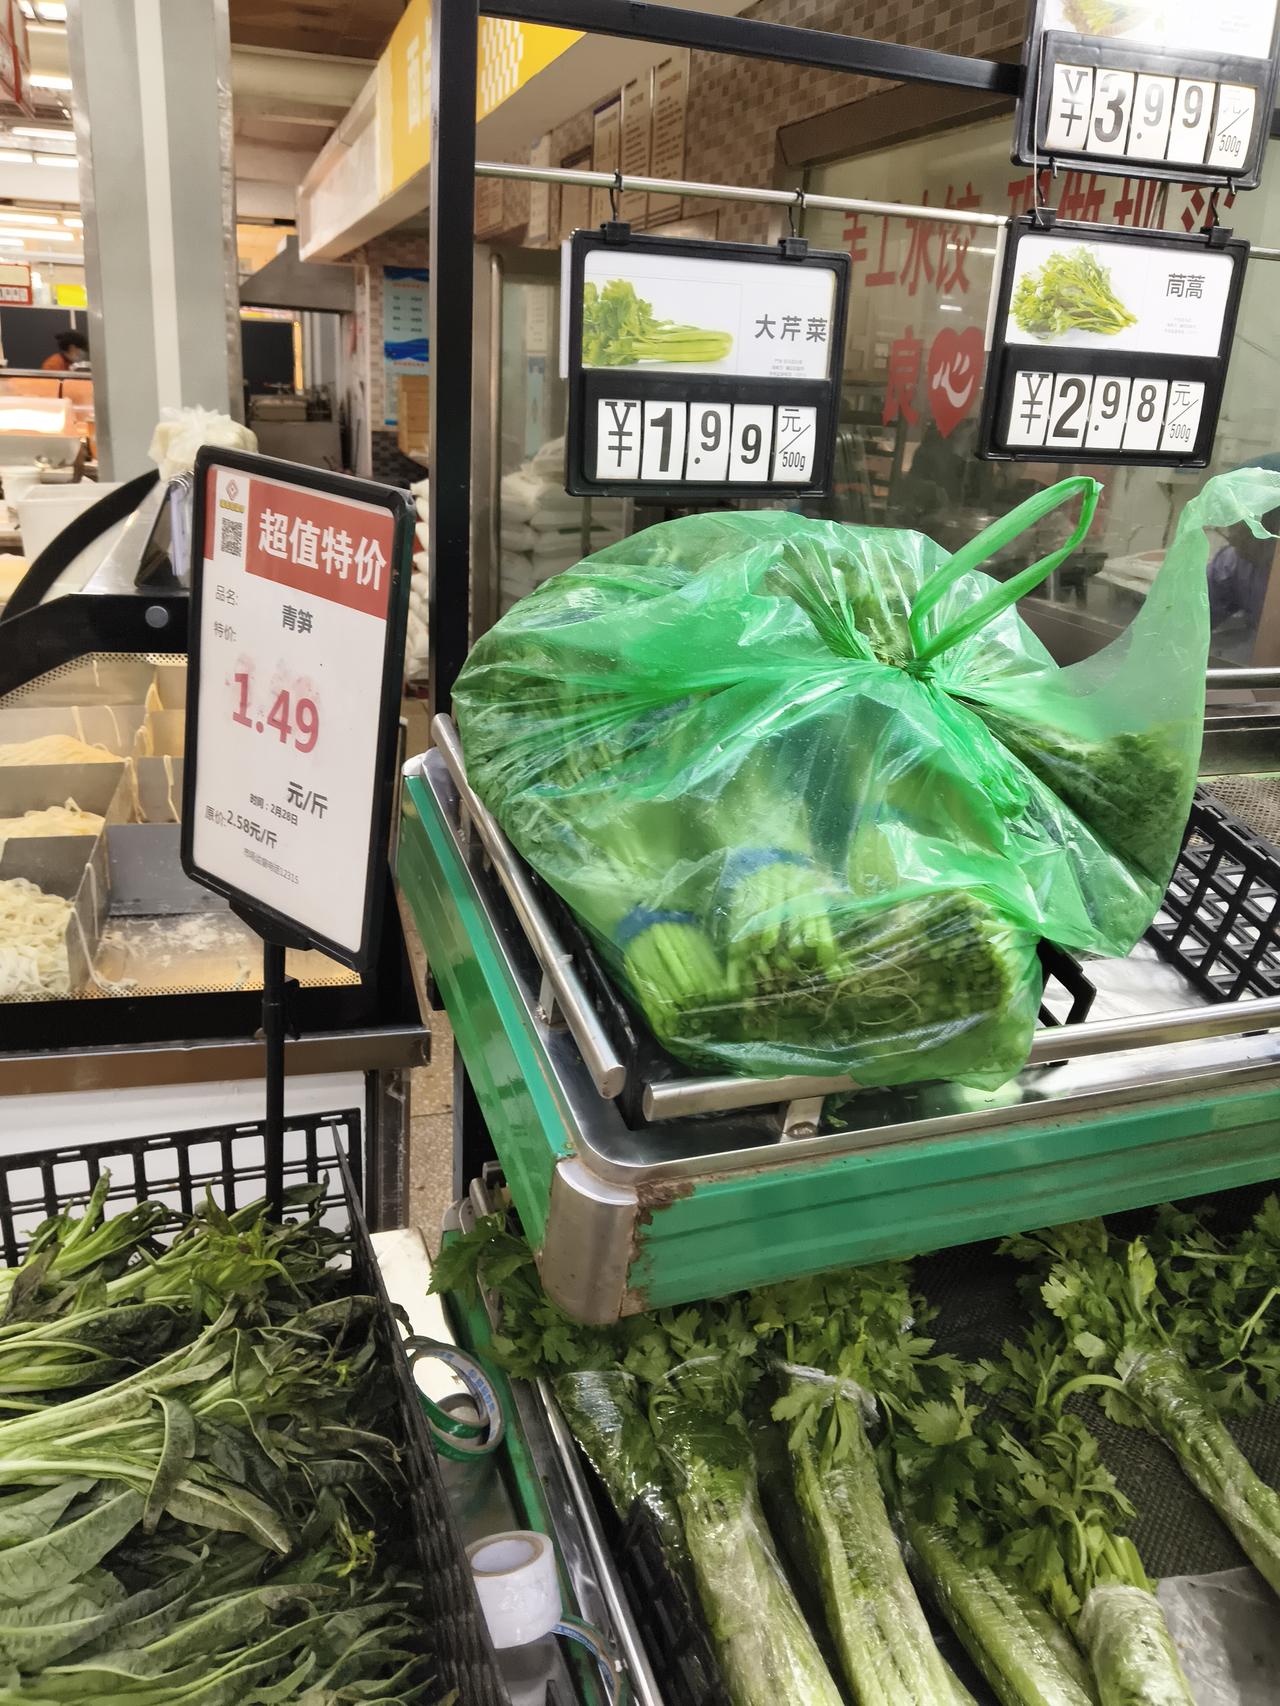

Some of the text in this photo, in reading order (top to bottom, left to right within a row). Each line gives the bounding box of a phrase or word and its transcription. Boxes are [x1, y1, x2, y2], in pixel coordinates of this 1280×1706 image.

[754, 313, 828, 343] 大芹菜
[258, 508, 387, 591] 超值特价
[282, 604, 314, 634] 青笋
[232, 672, 319, 754] 1.49
[287, 781, 328, 820] 元/斤
